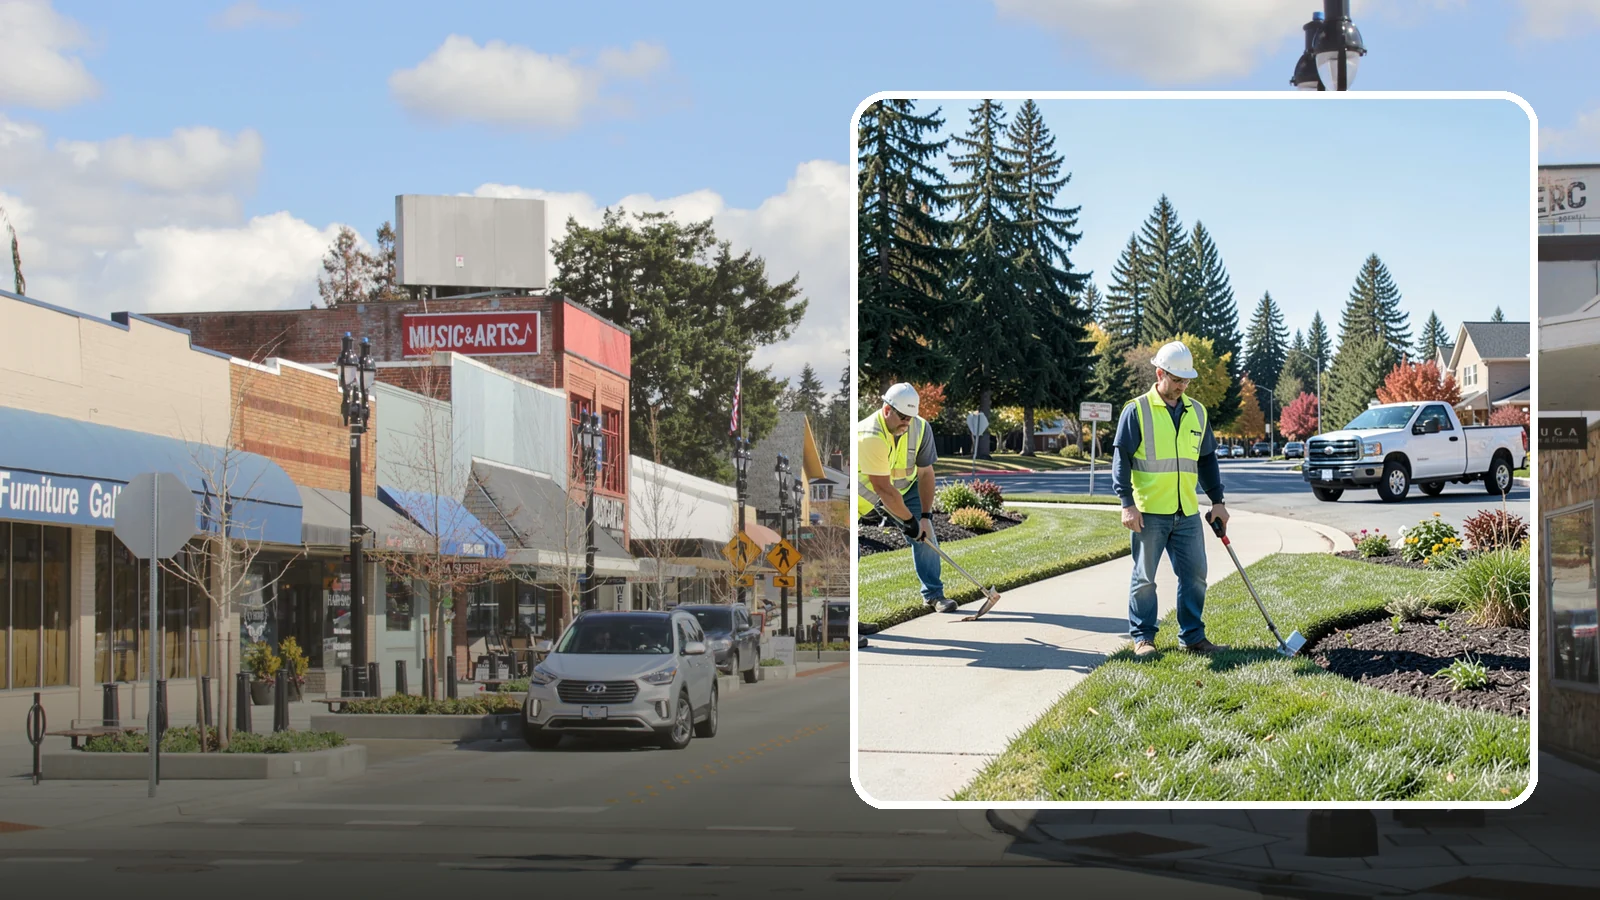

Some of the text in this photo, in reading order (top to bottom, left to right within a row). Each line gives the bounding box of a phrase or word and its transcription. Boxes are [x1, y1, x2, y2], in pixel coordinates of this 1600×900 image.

[409, 323, 519, 349] MUSIC&ARTS
[0, 471, 121, 519] Furniture Gal
[453, 563, 479, 574] SUSHI
